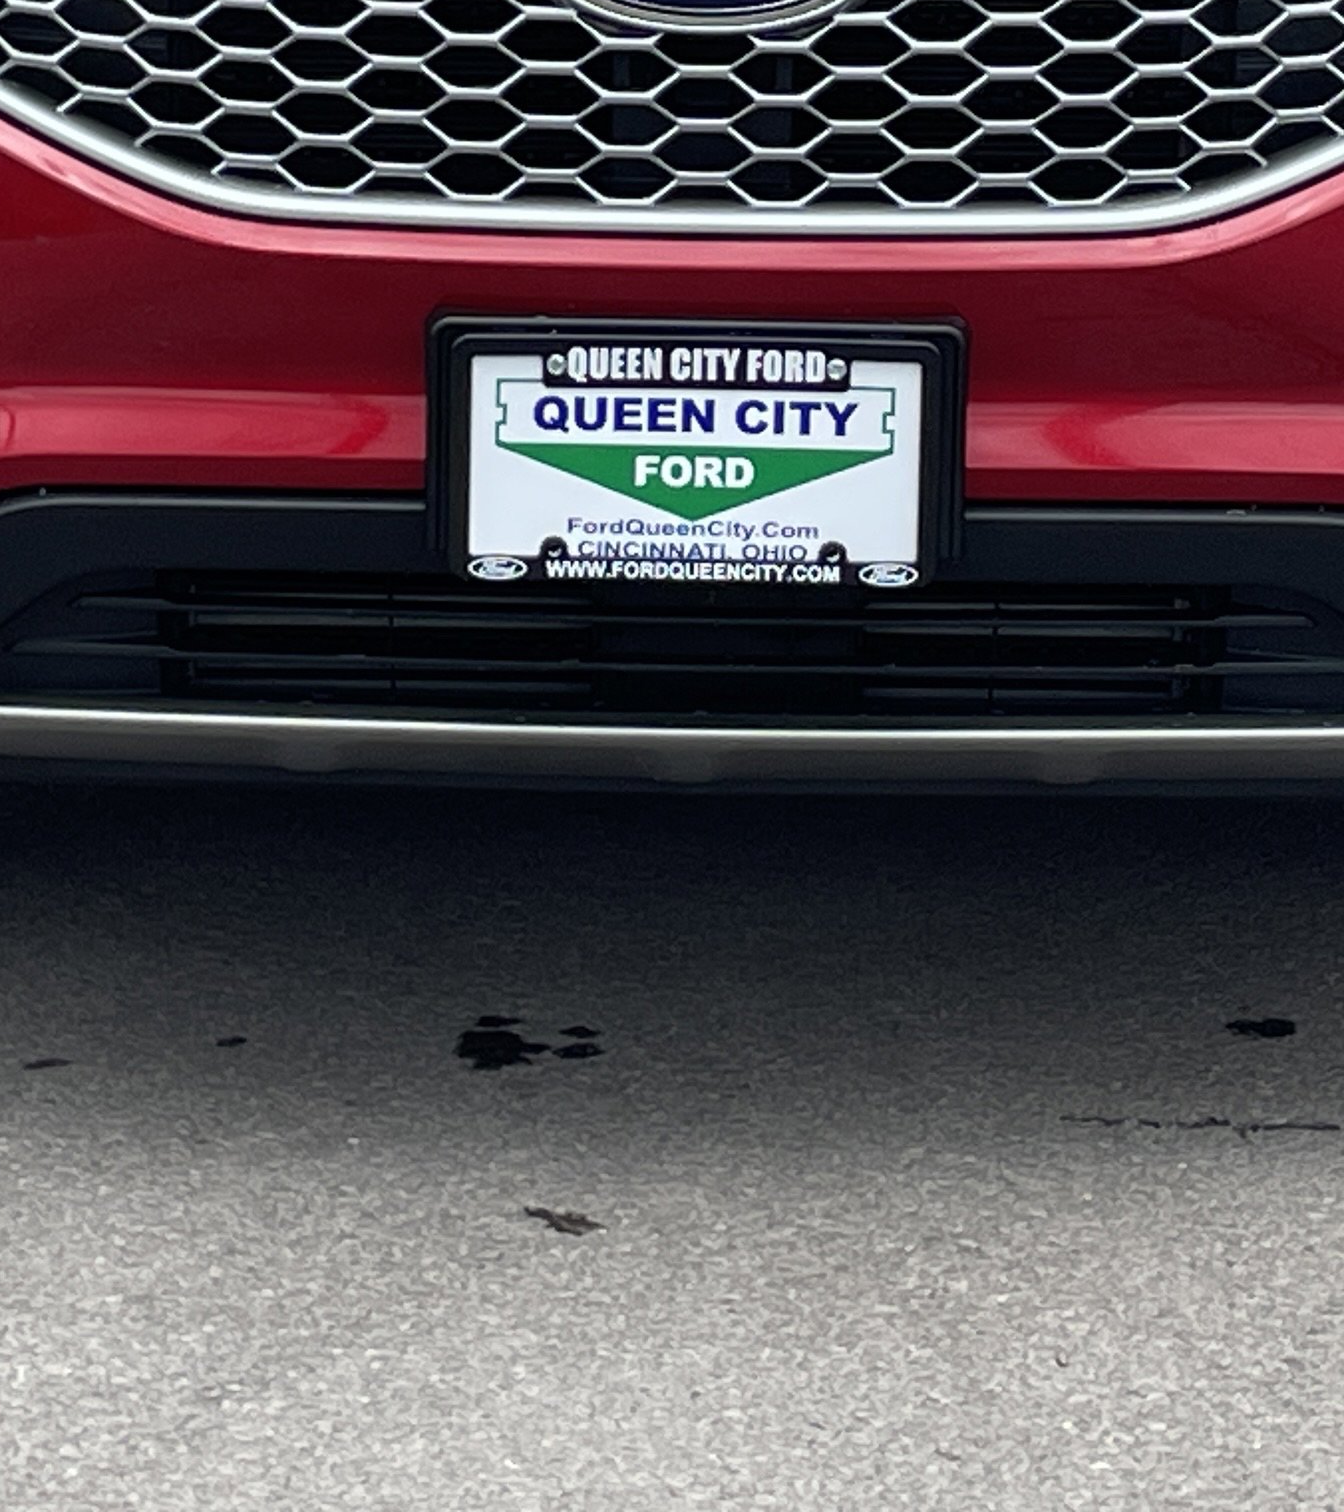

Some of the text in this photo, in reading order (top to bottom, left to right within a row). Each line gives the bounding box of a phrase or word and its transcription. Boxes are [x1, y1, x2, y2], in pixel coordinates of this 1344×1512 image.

[566, 346, 826, 384] QUEEN CITY FORD
[533, 395, 860, 437] QUEEN CITY
[633, 455, 754, 489] FORD
[567, 516, 820, 541] FordQueenCity.Com
[742, 543, 808, 562] OHIO
[545, 560, 841, 583] WWW.FORDQUEENCITY.COM
